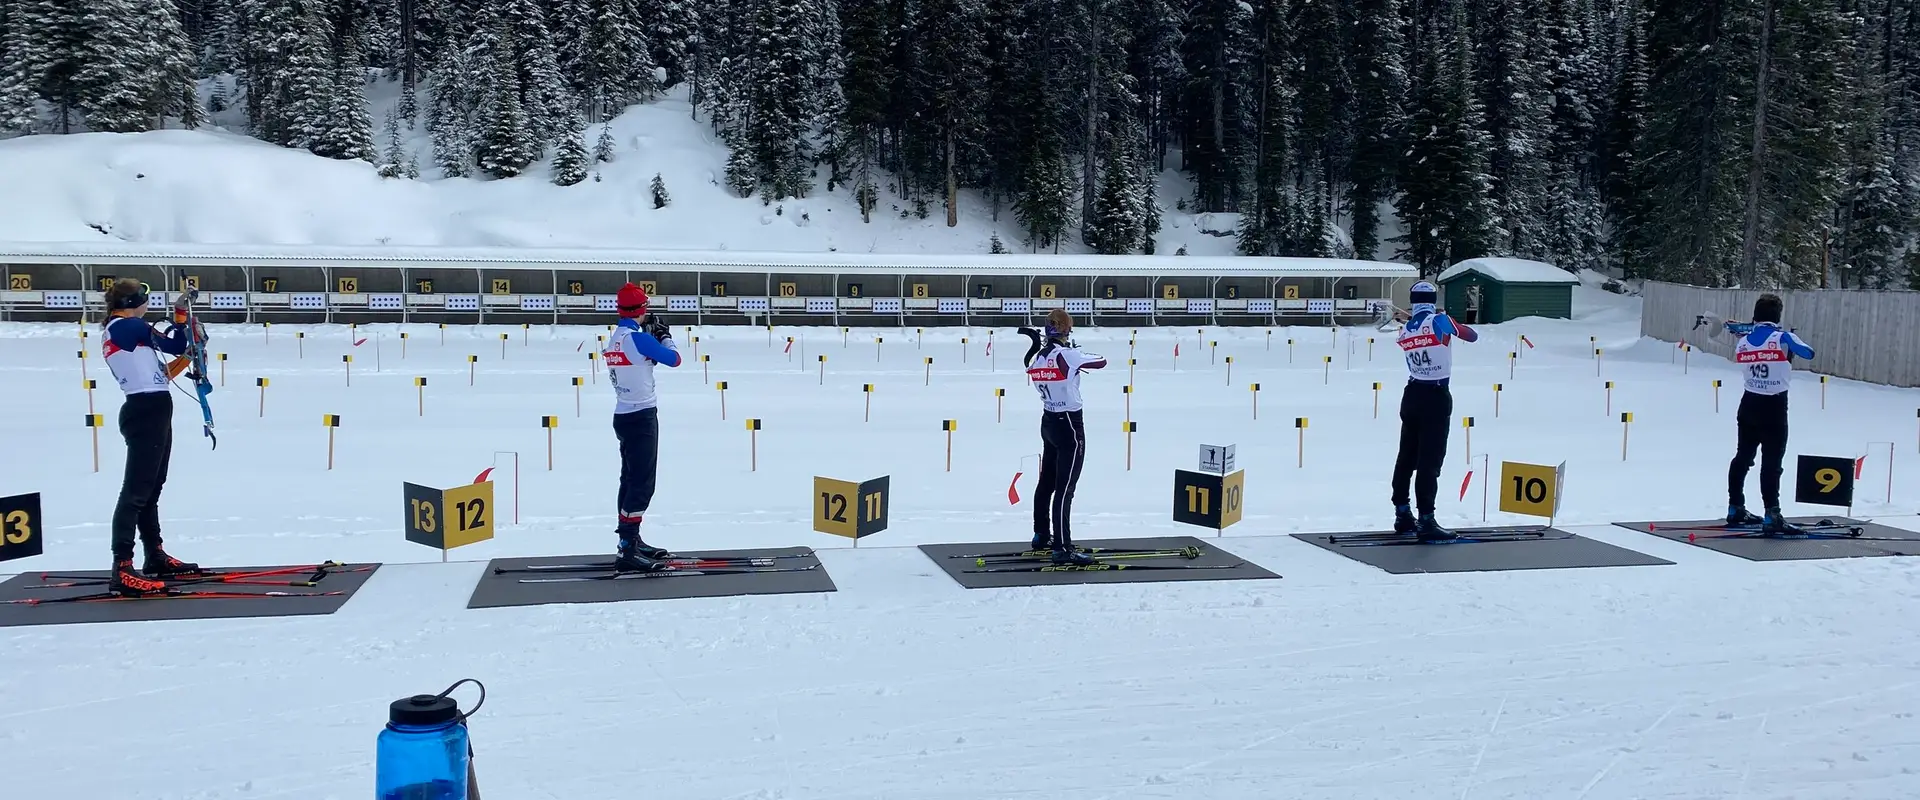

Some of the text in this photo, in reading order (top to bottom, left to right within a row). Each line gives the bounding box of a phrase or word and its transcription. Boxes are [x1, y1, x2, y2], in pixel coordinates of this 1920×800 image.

[11, 277, 30, 290] 20
[100, 277, 115, 292] 19
[263, 279, 277, 292] 17
[341, 280, 355, 292] 16
[418, 280, 432, 293] 15
[495, 281, 508, 292] 14
[569, 282, 582, 294] 13
[642, 283, 654, 295] 12
[713, 284, 725, 296] 11
[781, 285, 795, 296] 10
[851, 285, 859, 296] 9
[917, 286, 924, 297] 8
[981, 286, 988, 297] 7
[1045, 286, 1052, 297] 6
[1107, 287, 1114, 298] 5
[1167, 287, 1175, 298] 4
[1228, 287, 1236, 298] 3
[1288, 287, 1295, 298] 2
[1348, 288, 1354, 298] 1
[1740, 351, 1779, 361] Jeep Eagle
[1749, 363, 1769, 379] 119
[1814, 467, 1842, 494] 9
[1512, 475, 1547, 504] 10
[1185, 484, 1210, 516] 11
[1226, 484, 1240, 514] 10
[821, 491, 847, 523] 12
[864, 491, 882, 523] 11
[411, 498, 437, 533] 13
[455, 497, 486, 532] 12
[1040, 564, 1111, 573] FISCHER
